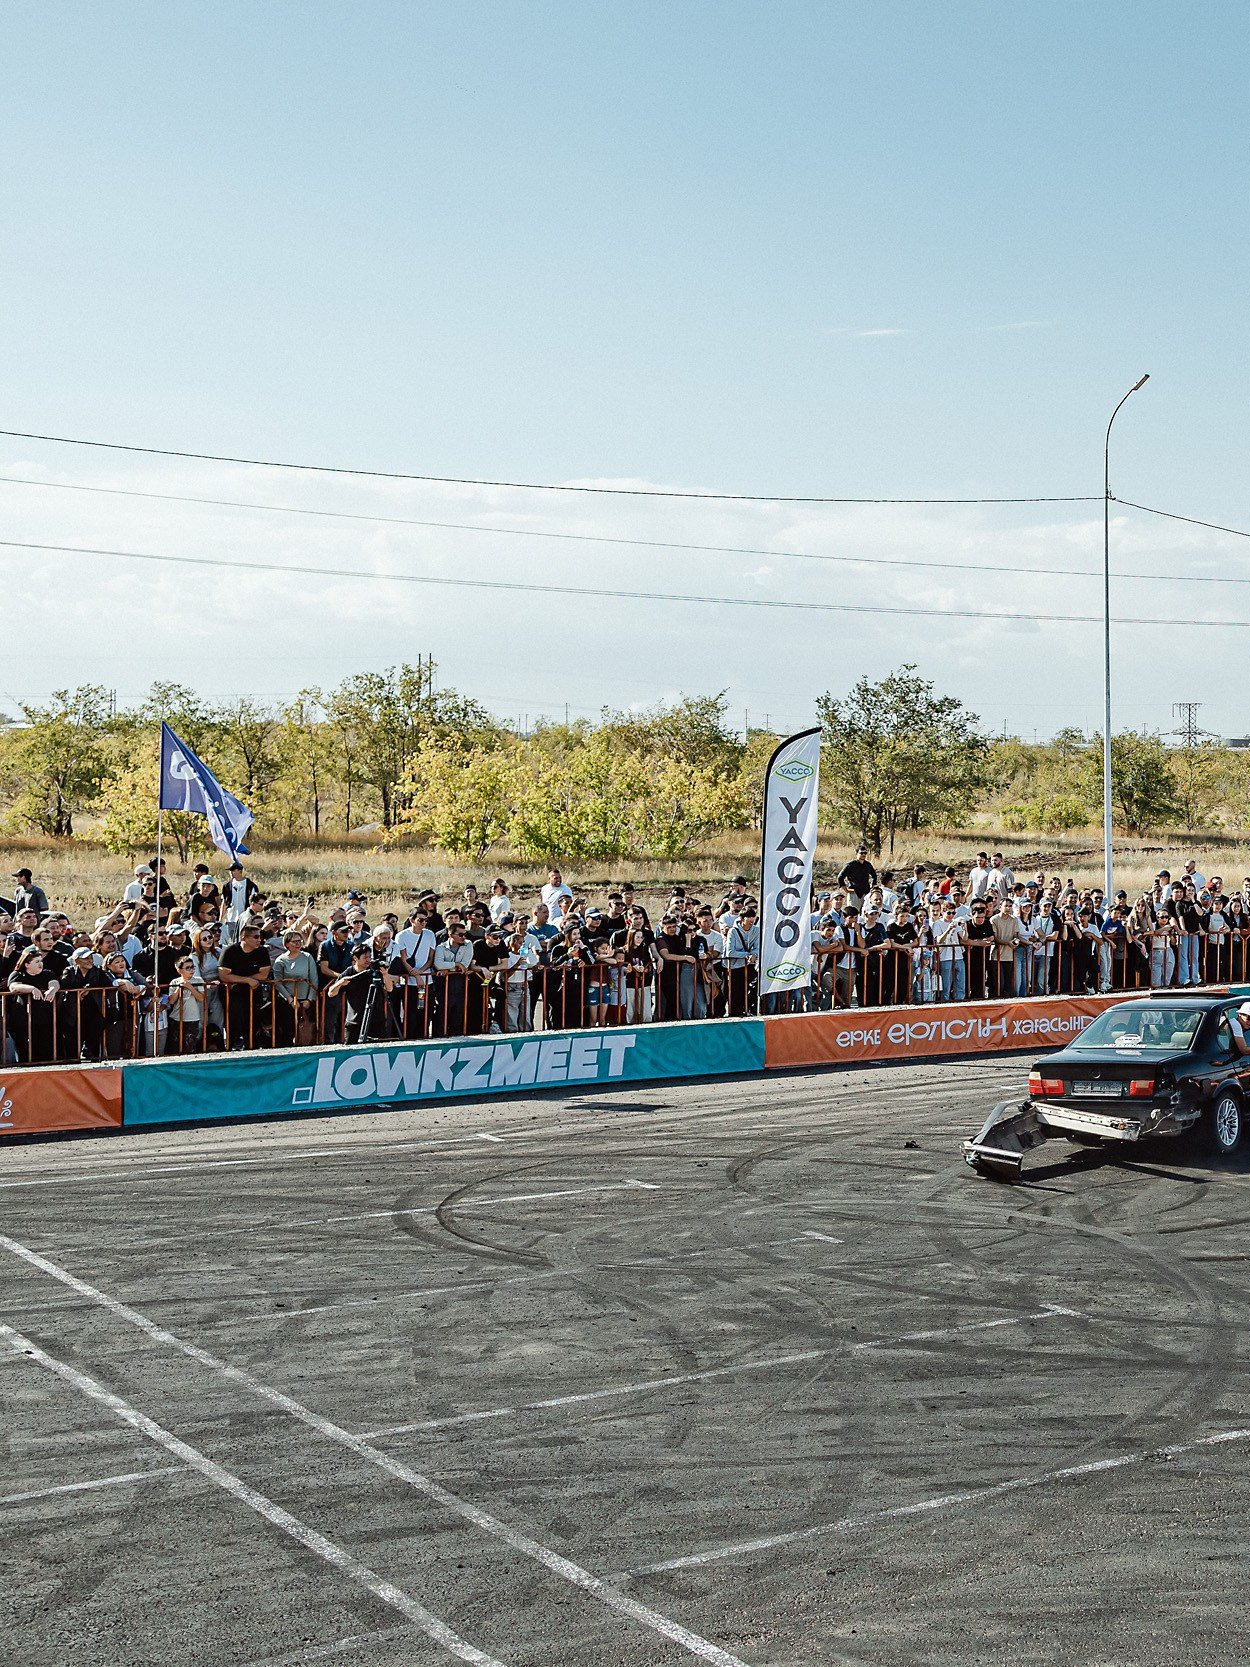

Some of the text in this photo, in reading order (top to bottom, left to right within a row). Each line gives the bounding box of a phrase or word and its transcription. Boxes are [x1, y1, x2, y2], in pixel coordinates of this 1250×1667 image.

[780, 767, 810, 775] YACCO
[774, 796, 808, 949] YACCO
[771, 967, 802, 977] YACCO
[312, 1033, 637, 1104] LOWKZMEET
